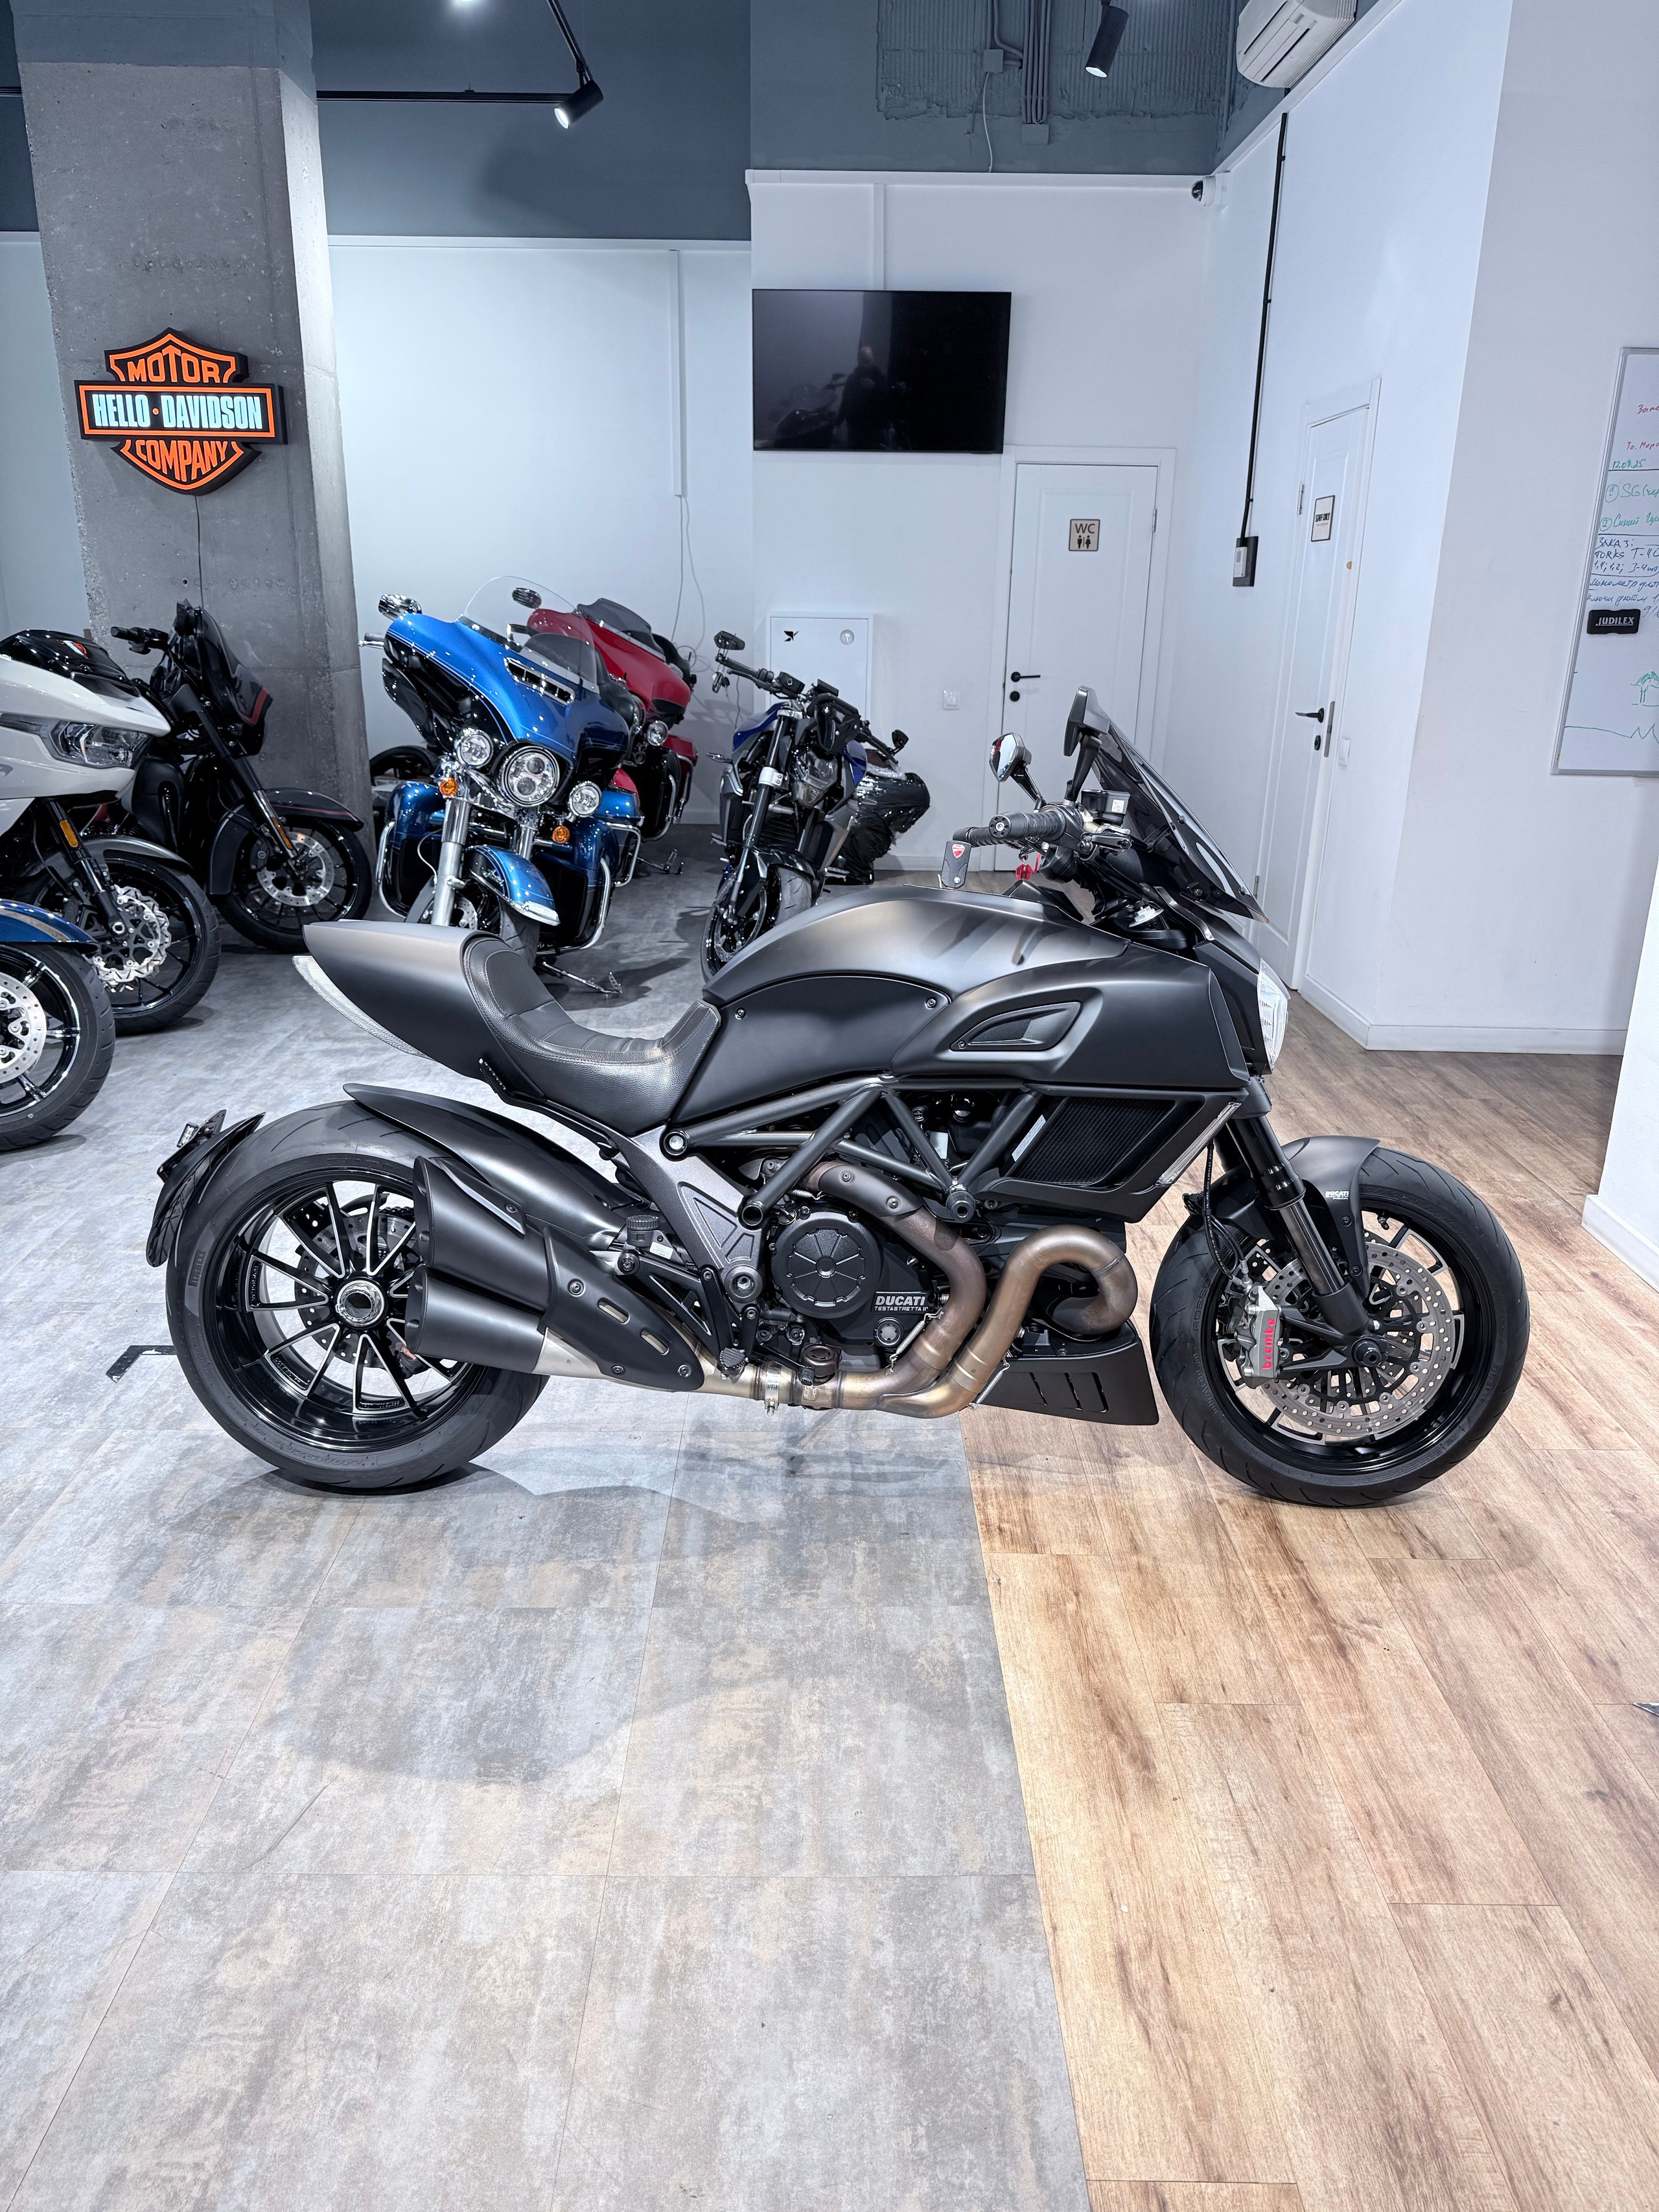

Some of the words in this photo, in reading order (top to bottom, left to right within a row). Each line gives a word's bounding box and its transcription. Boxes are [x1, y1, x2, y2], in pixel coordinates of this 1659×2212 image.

[127, 345, 220, 383] MOTOR
[92, 394, 150, 427] HELLO
[161, 395, 262, 429] DAVIDSON
[135, 440, 227, 482] COMPANY
[1074, 523, 1095, 533] WC
[1595, 616, 1634, 626] JUDILEX
[876, 1296, 925, 1305] DUCATI
[1261, 1318, 1276, 1370] brembo
